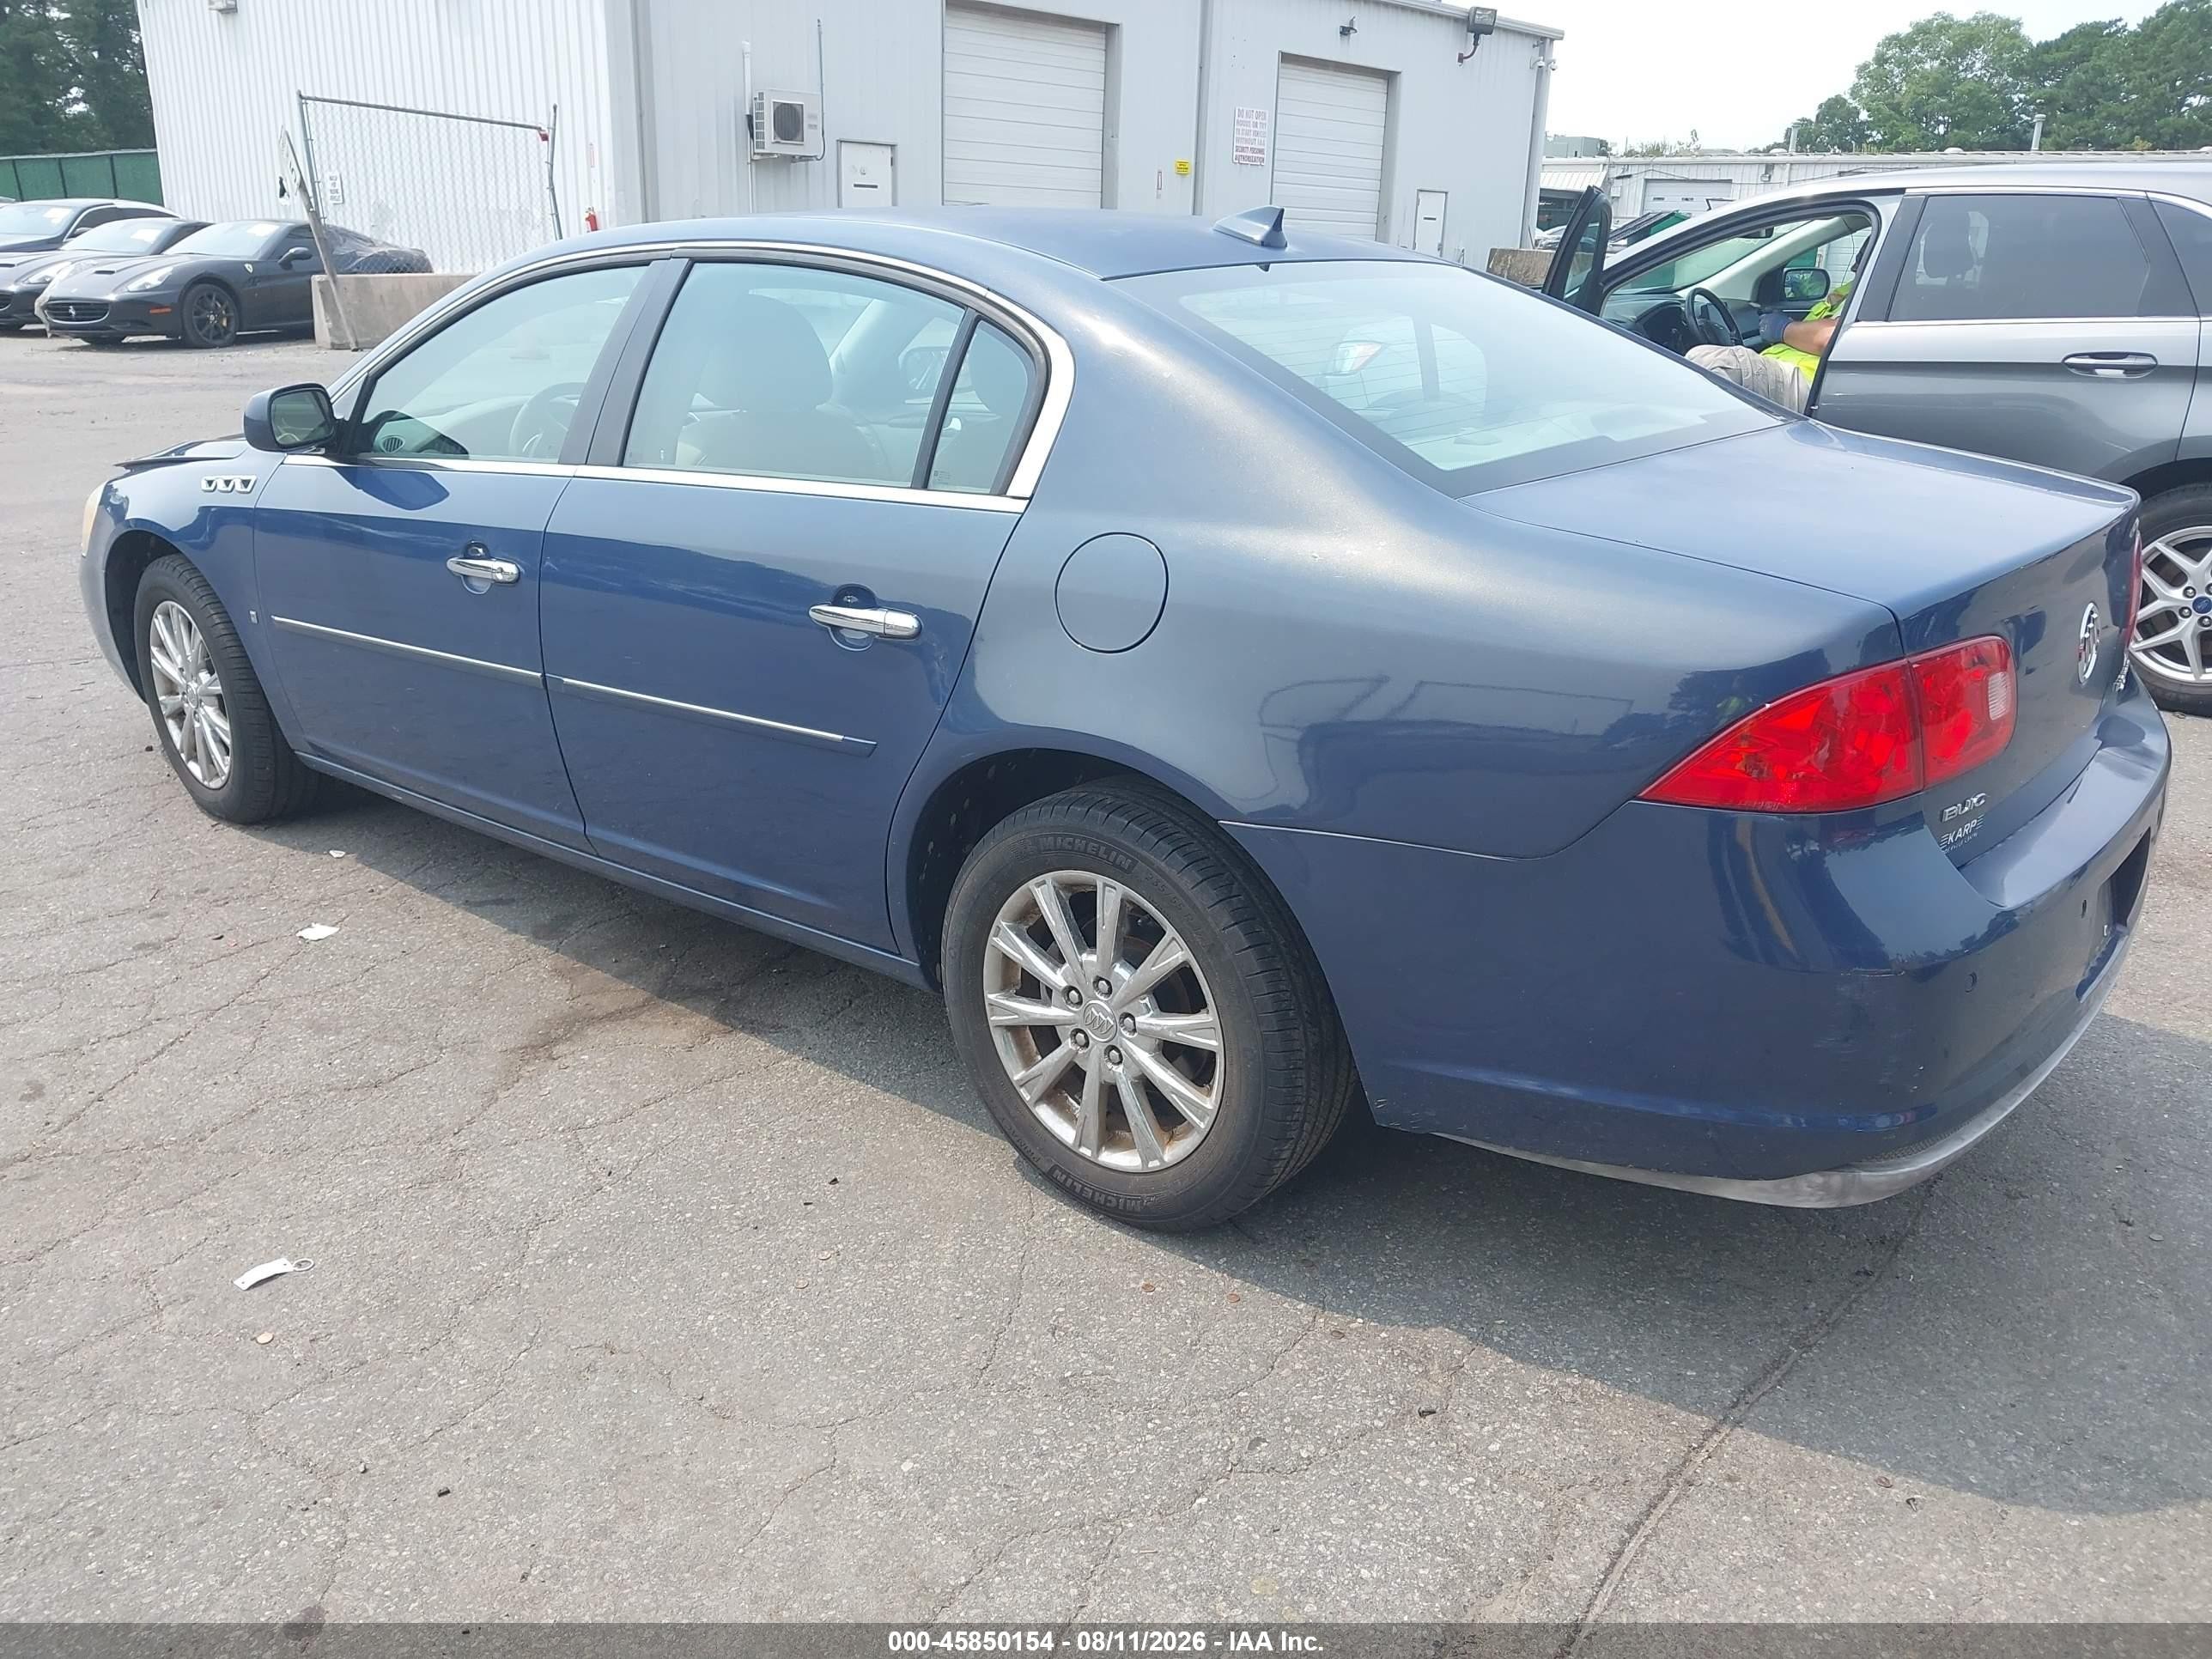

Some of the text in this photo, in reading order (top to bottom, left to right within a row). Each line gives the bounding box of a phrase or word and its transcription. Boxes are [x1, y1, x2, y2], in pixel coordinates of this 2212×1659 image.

[1237, 108, 1267, 120] DO NOT OPEN
[1235, 155, 1265, 163] AUTHORIZATION
[1947, 818, 1978, 846] KARP
[1039, 836, 1133, 870] MICHELIN
[1052, 1169, 1142, 1212] MICHELIN
